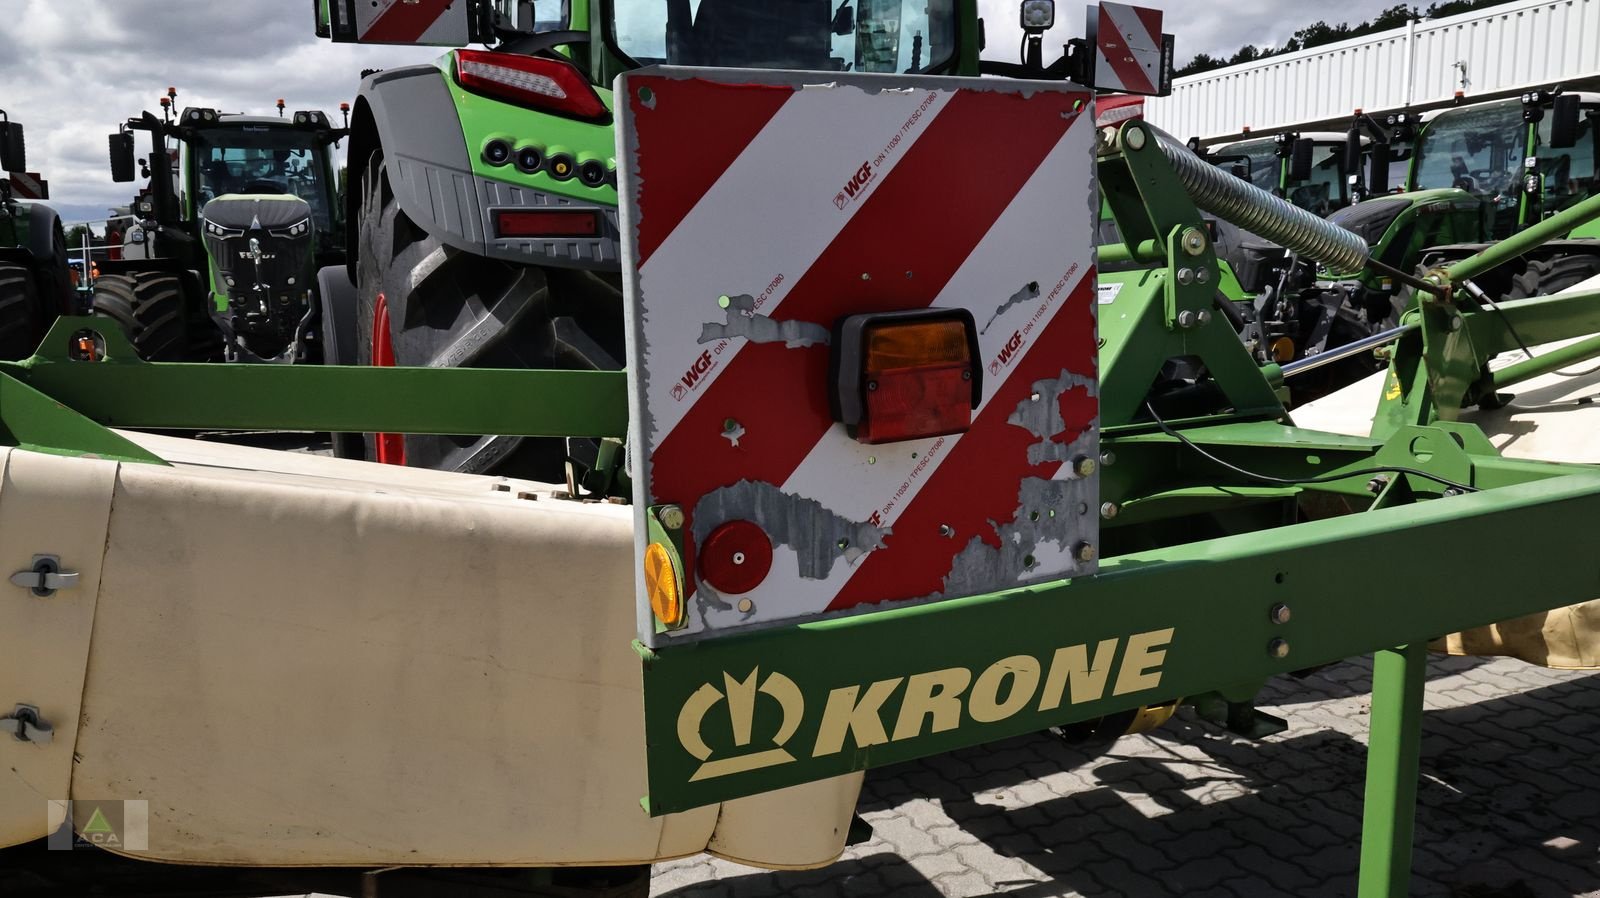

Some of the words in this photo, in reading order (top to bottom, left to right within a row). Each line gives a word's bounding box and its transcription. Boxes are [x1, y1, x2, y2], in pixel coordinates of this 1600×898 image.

[843, 160, 872, 198] WGF
[873, 153, 886, 167] DIN
[884, 134, 901, 154] 11030
[901, 109, 923, 133] TPESC
[920, 91, 938, 112] 07080
[681, 349, 712, 388] WGF
[713, 340, 728, 355] DIN
[765, 273, 785, 295] 07080
[997, 329, 1022, 364] WGF
[1022, 321, 1034, 335] DIN
[1032, 304, 1047, 322] 11030
[1047, 279, 1065, 302] TPESC
[1063, 262, 1079, 281] 07080
[882, 500, 895, 515] DIN
[893, 481, 910, 501] 11030
[909, 455, 930, 479] TPESC
[928, 437, 945, 457] 07080
[811, 627, 1175, 757] KRONE
